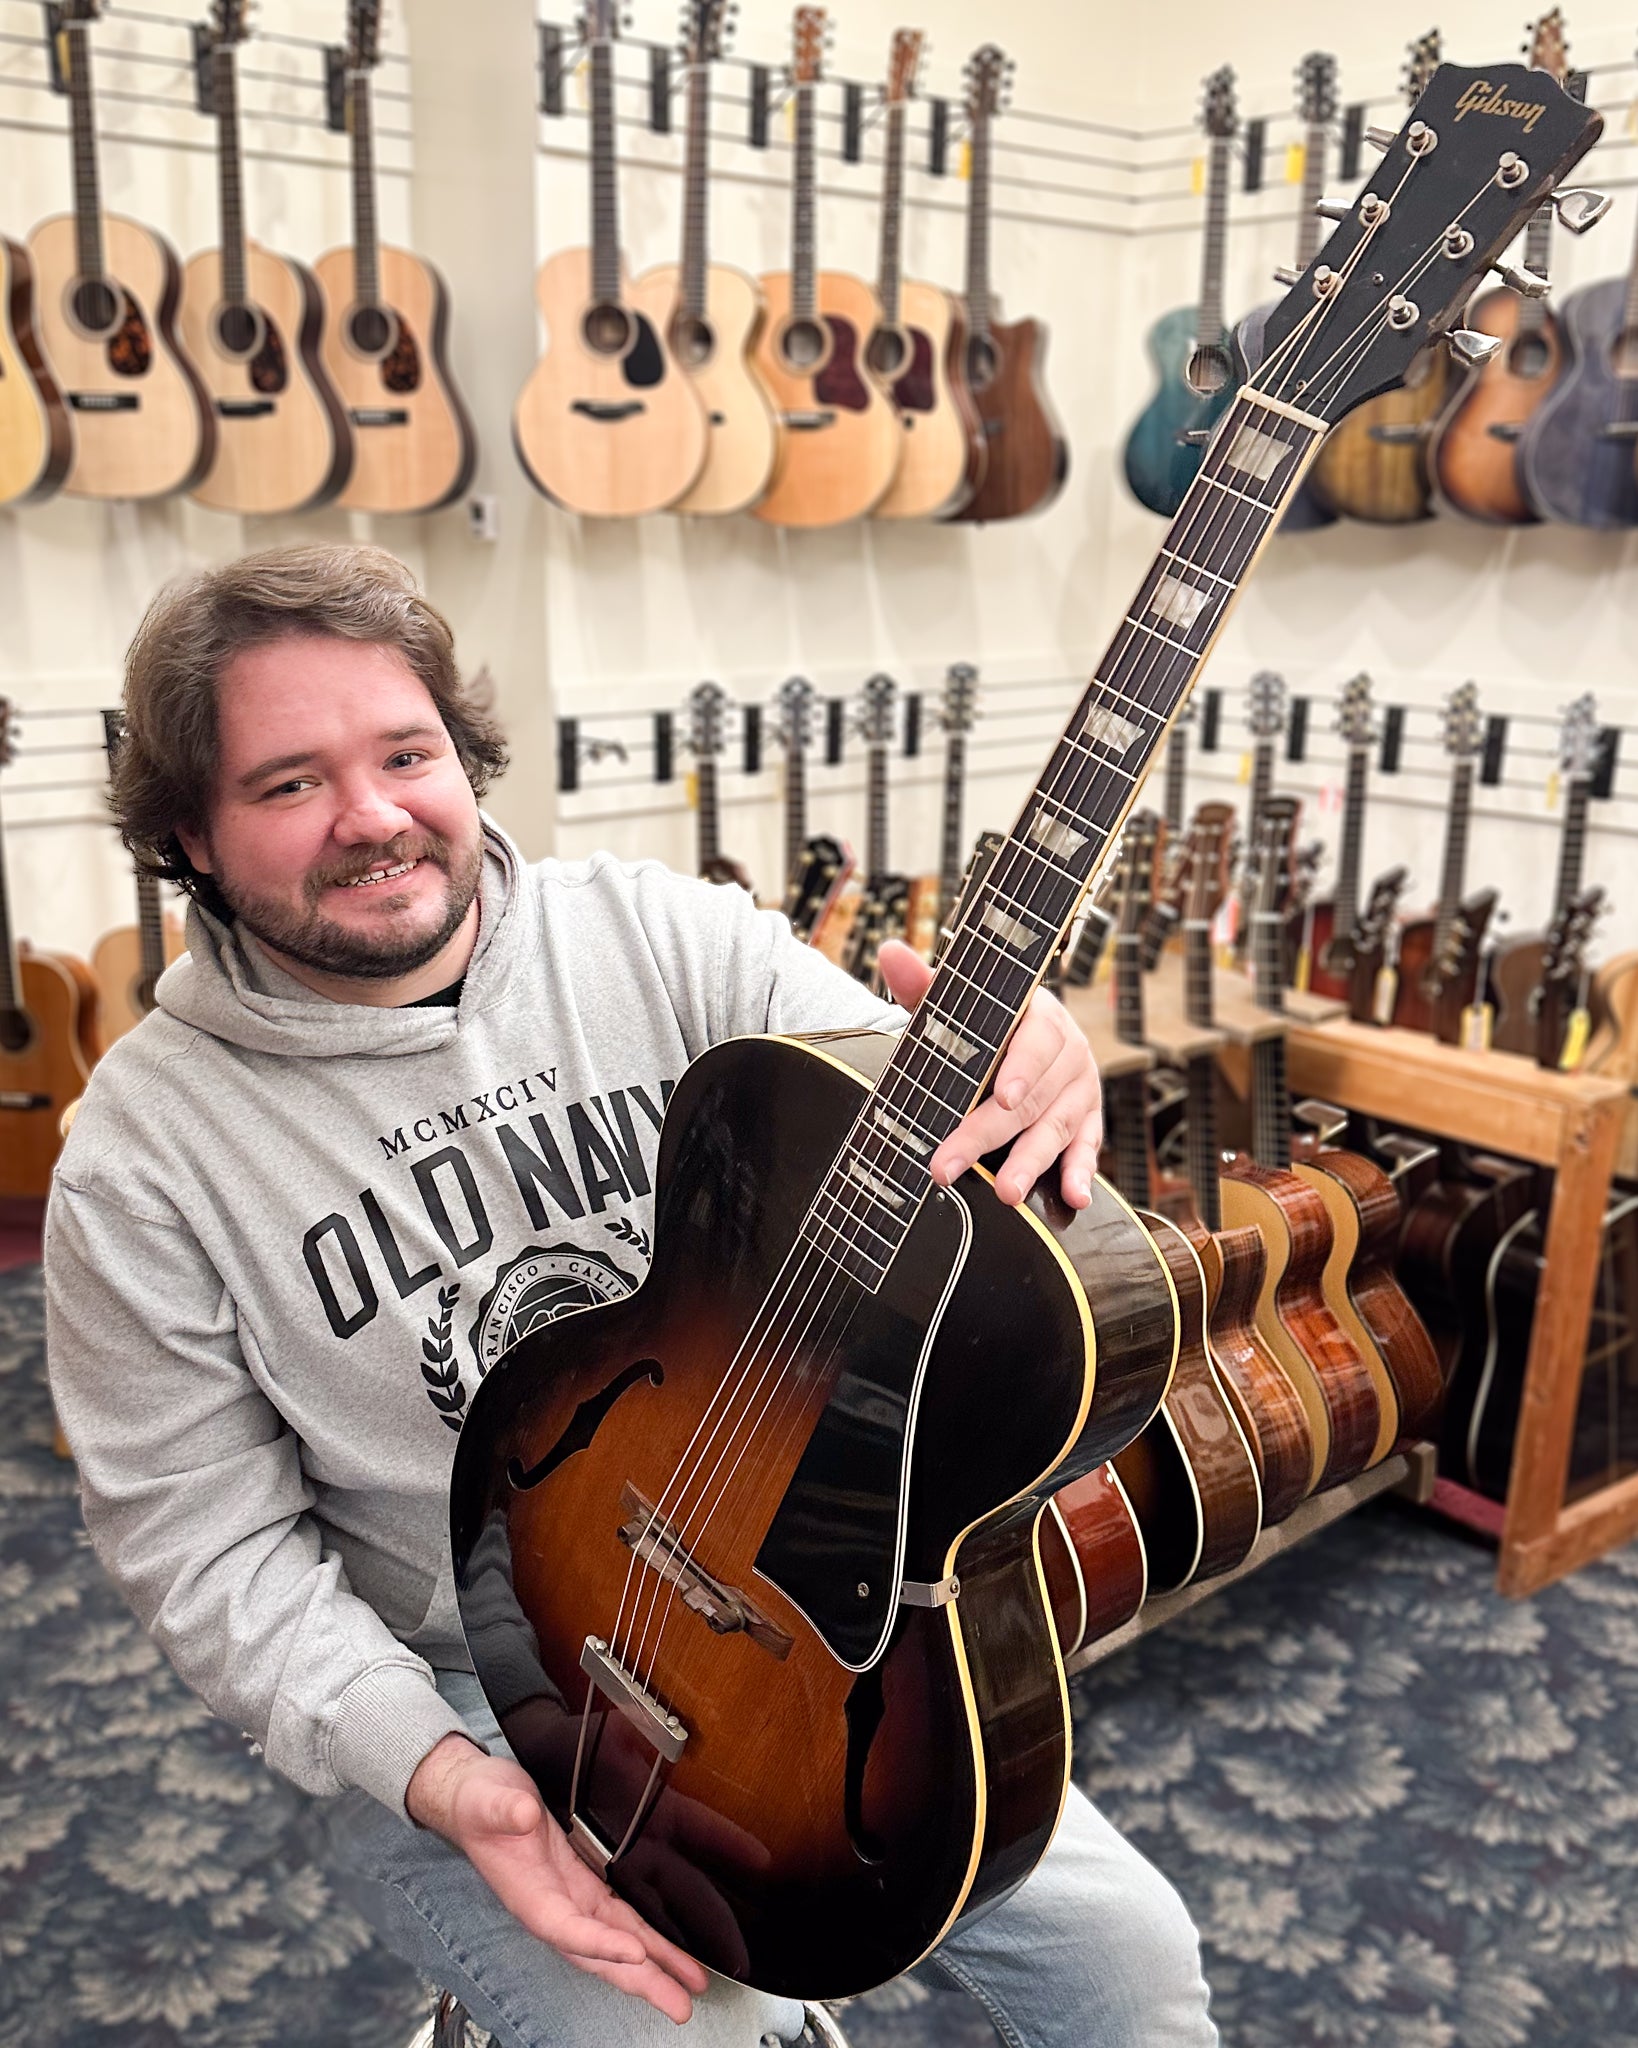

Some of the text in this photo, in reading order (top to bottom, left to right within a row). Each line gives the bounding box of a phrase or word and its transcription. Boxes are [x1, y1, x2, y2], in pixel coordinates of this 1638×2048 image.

[1453, 79, 1547, 134] Gibson
[377, 1067, 557, 1160] MCMXCIV
[302, 1145, 494, 1340] OLD
[486, 1264, 538, 1367] RANCISCO
